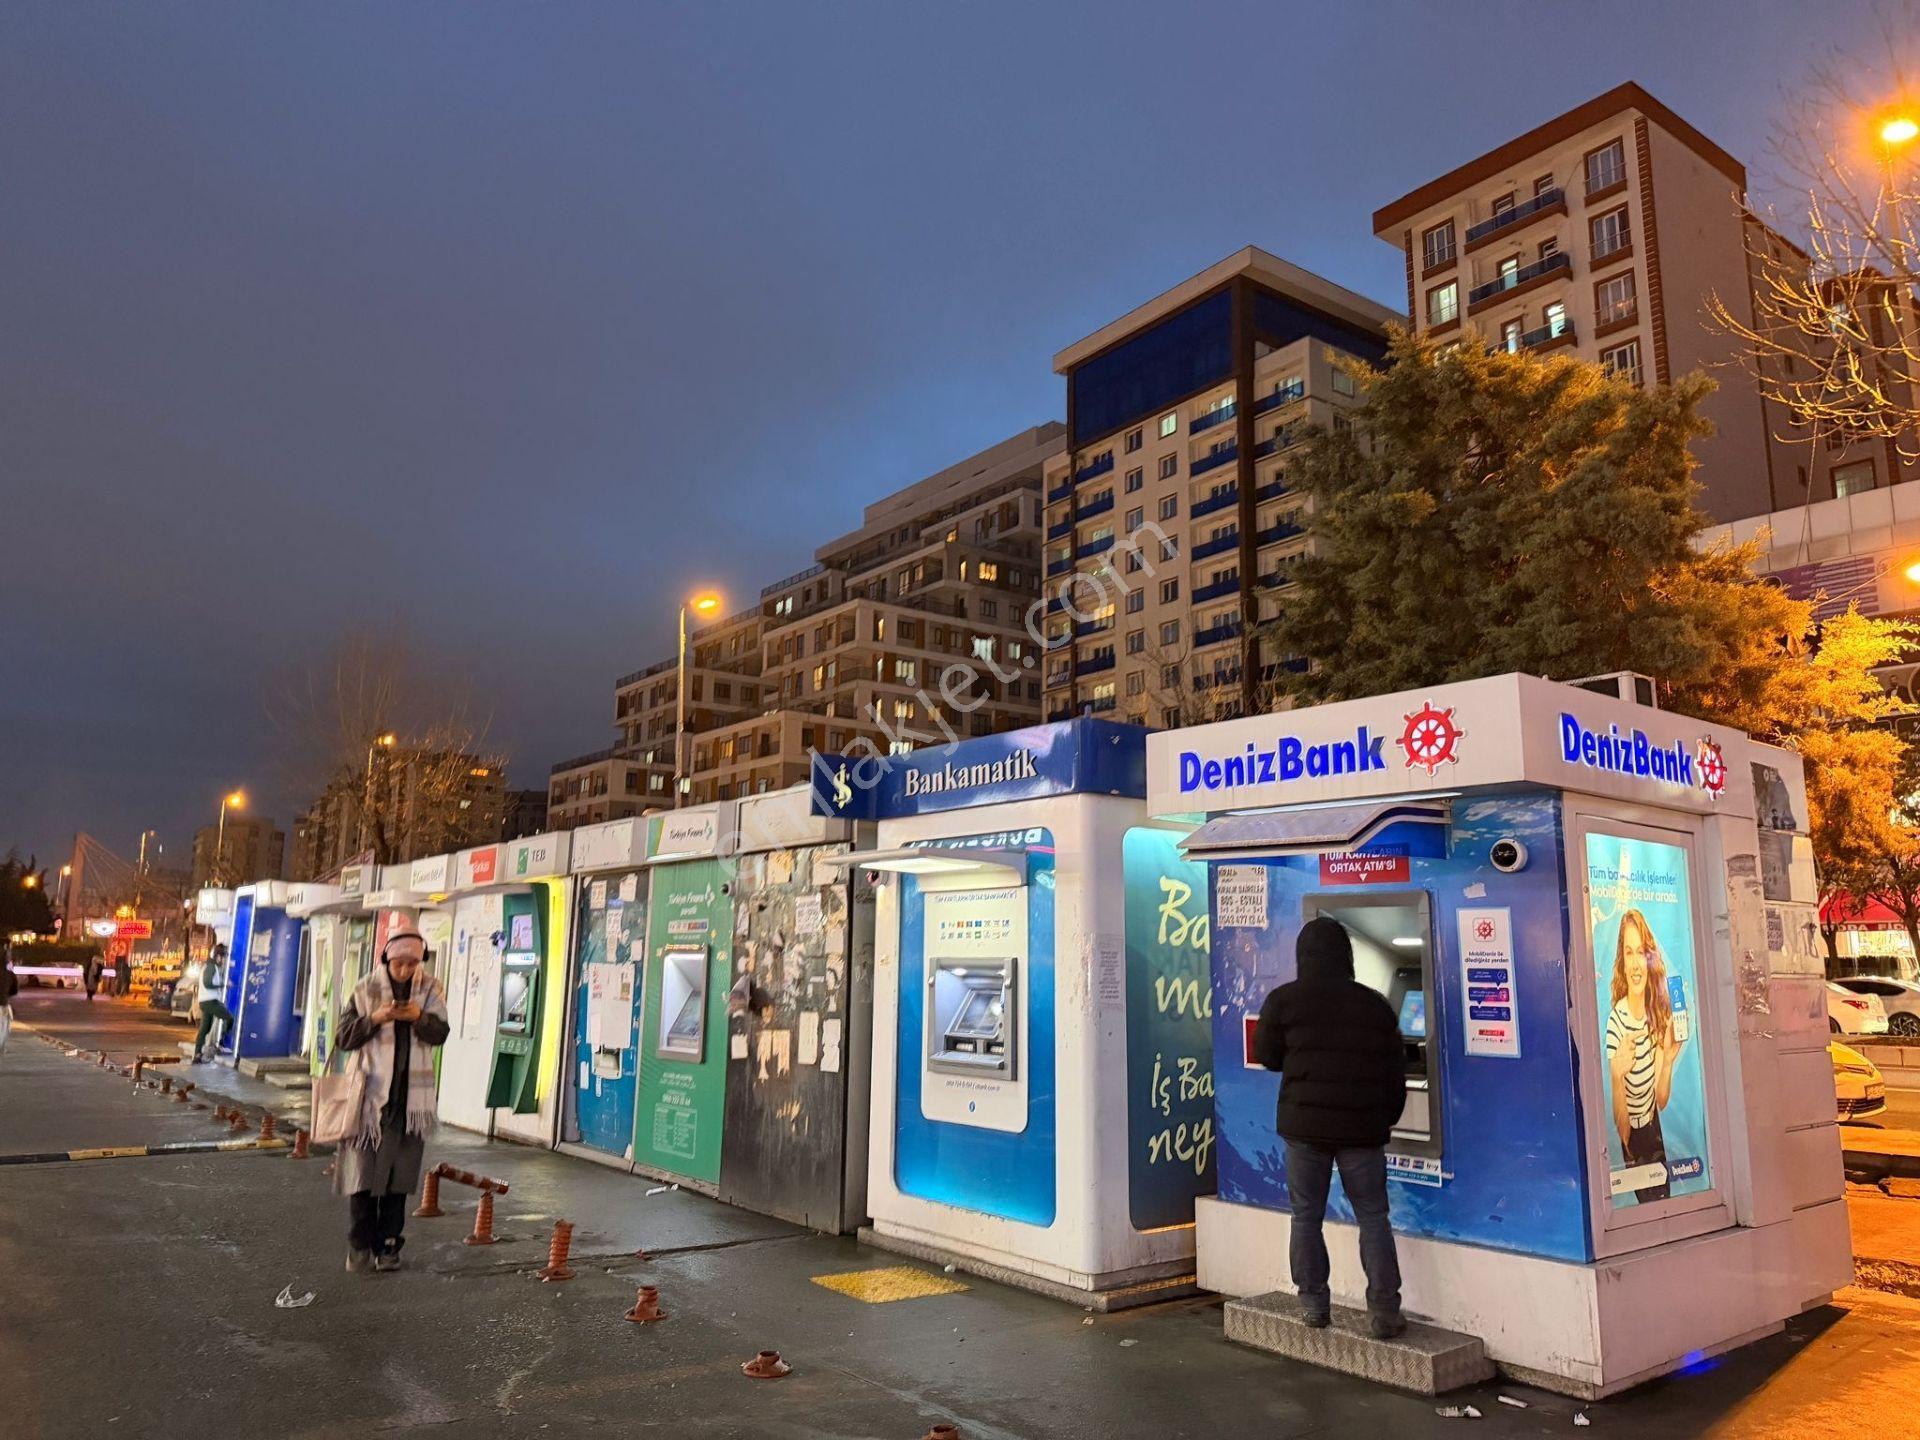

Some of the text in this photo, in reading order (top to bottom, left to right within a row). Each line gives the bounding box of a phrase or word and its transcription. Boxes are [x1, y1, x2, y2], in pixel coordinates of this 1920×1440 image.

[903, 748, 1038, 797] Bankamatik
[1179, 726, 1387, 793] DenizBank
[1560, 712, 1694, 787] DenizBank
[1329, 862, 1361, 874] ORTAK
[1589, 865, 1607, 879] Tüm
[1151, 1052, 1171, 1117] İş
